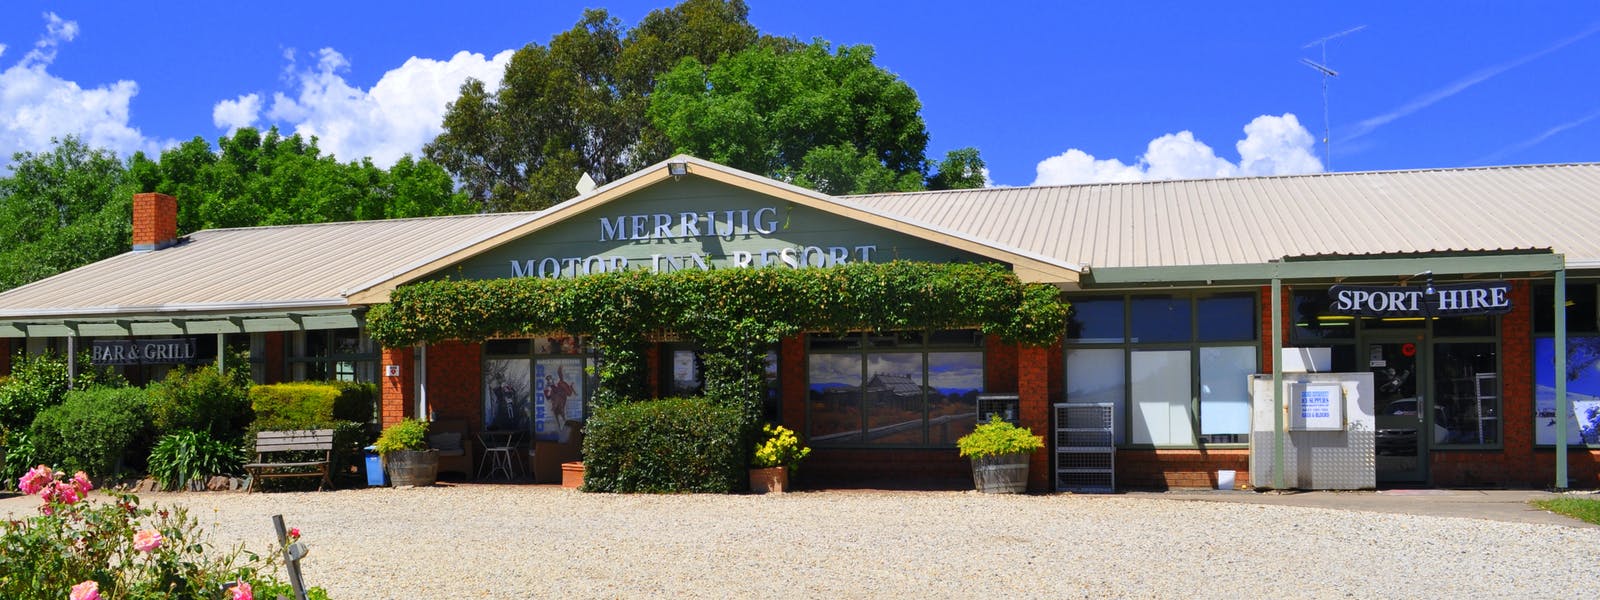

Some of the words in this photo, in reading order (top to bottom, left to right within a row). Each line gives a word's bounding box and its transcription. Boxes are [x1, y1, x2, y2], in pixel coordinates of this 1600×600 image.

[600, 207, 778, 241] MERRIJIG
[510, 255, 629, 279] MOTOR
[1337, 290, 1423, 312] SPORT
[1438, 287, 1508, 310] HIRE
[93, 345, 124, 361] BAR
[128, 344, 139, 359] &
[144, 343, 195, 359] GRILL
